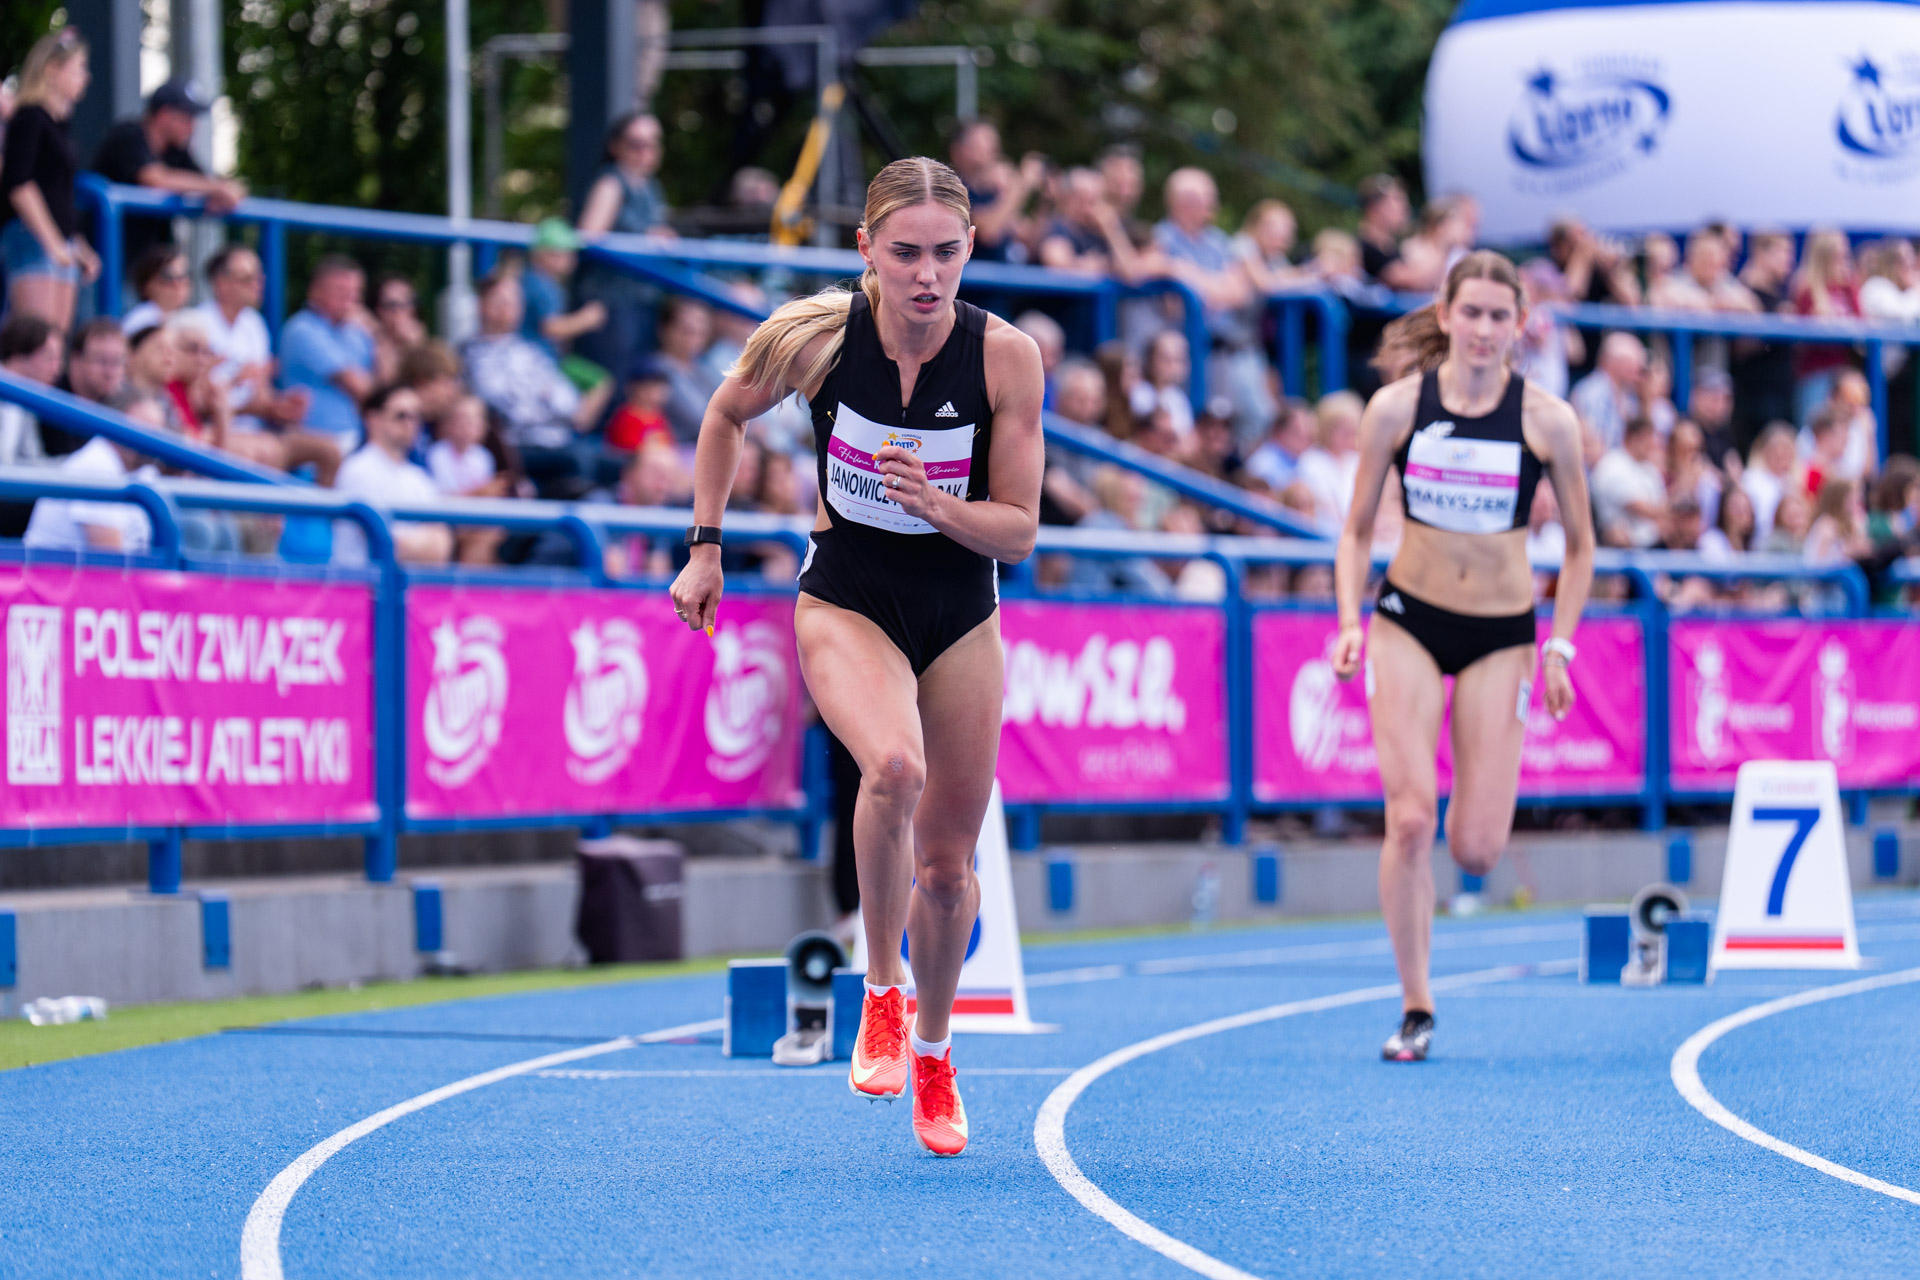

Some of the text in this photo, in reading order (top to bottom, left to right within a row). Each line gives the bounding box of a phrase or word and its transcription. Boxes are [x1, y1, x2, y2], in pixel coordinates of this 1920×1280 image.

[75, 607, 347, 698] POLSKI ZWIĄZEK
[75, 715, 201, 786] LEKKIEJ
[206, 716, 351, 786] ATLETYKI
[1753, 808, 1821, 915] 7
